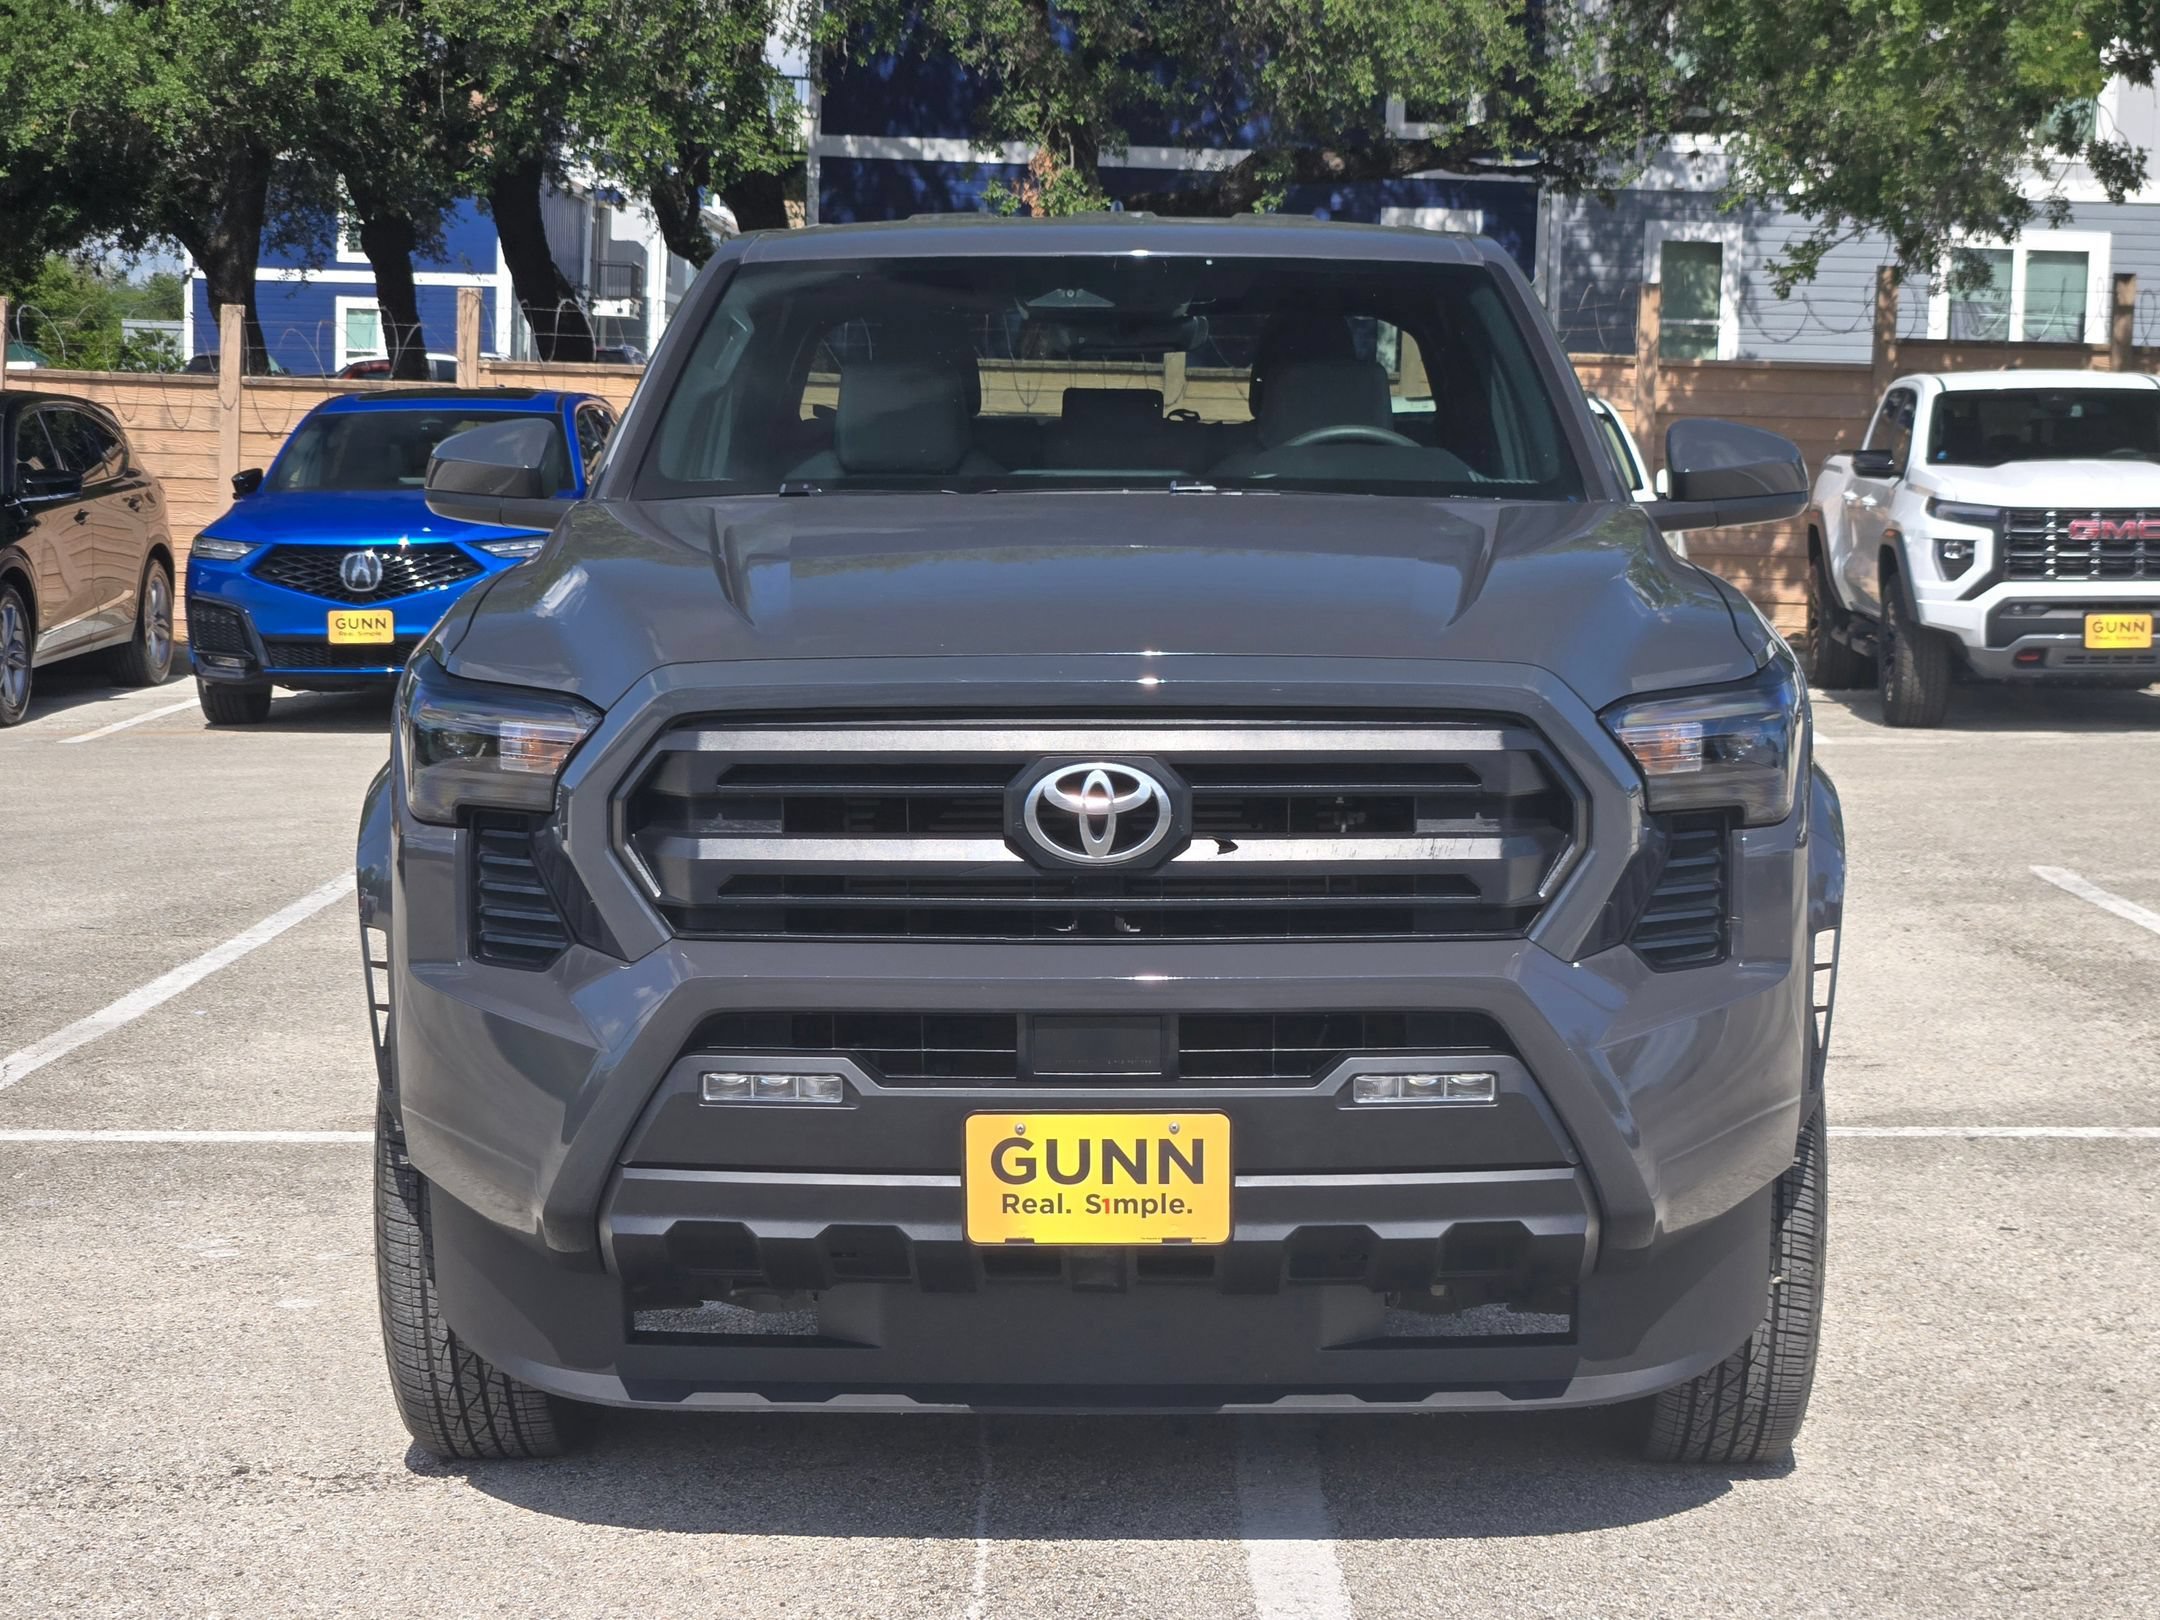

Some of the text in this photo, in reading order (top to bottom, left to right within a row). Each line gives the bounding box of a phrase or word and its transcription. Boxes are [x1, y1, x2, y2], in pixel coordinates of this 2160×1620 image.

[2068, 519, 2160, 540] GMC
[335, 617, 387, 630] GUNN
[2092, 621, 2145, 633] GUNN
[990, 1137, 1204, 1186] GUNN
[1002, 1193, 1072, 1214] Real.
